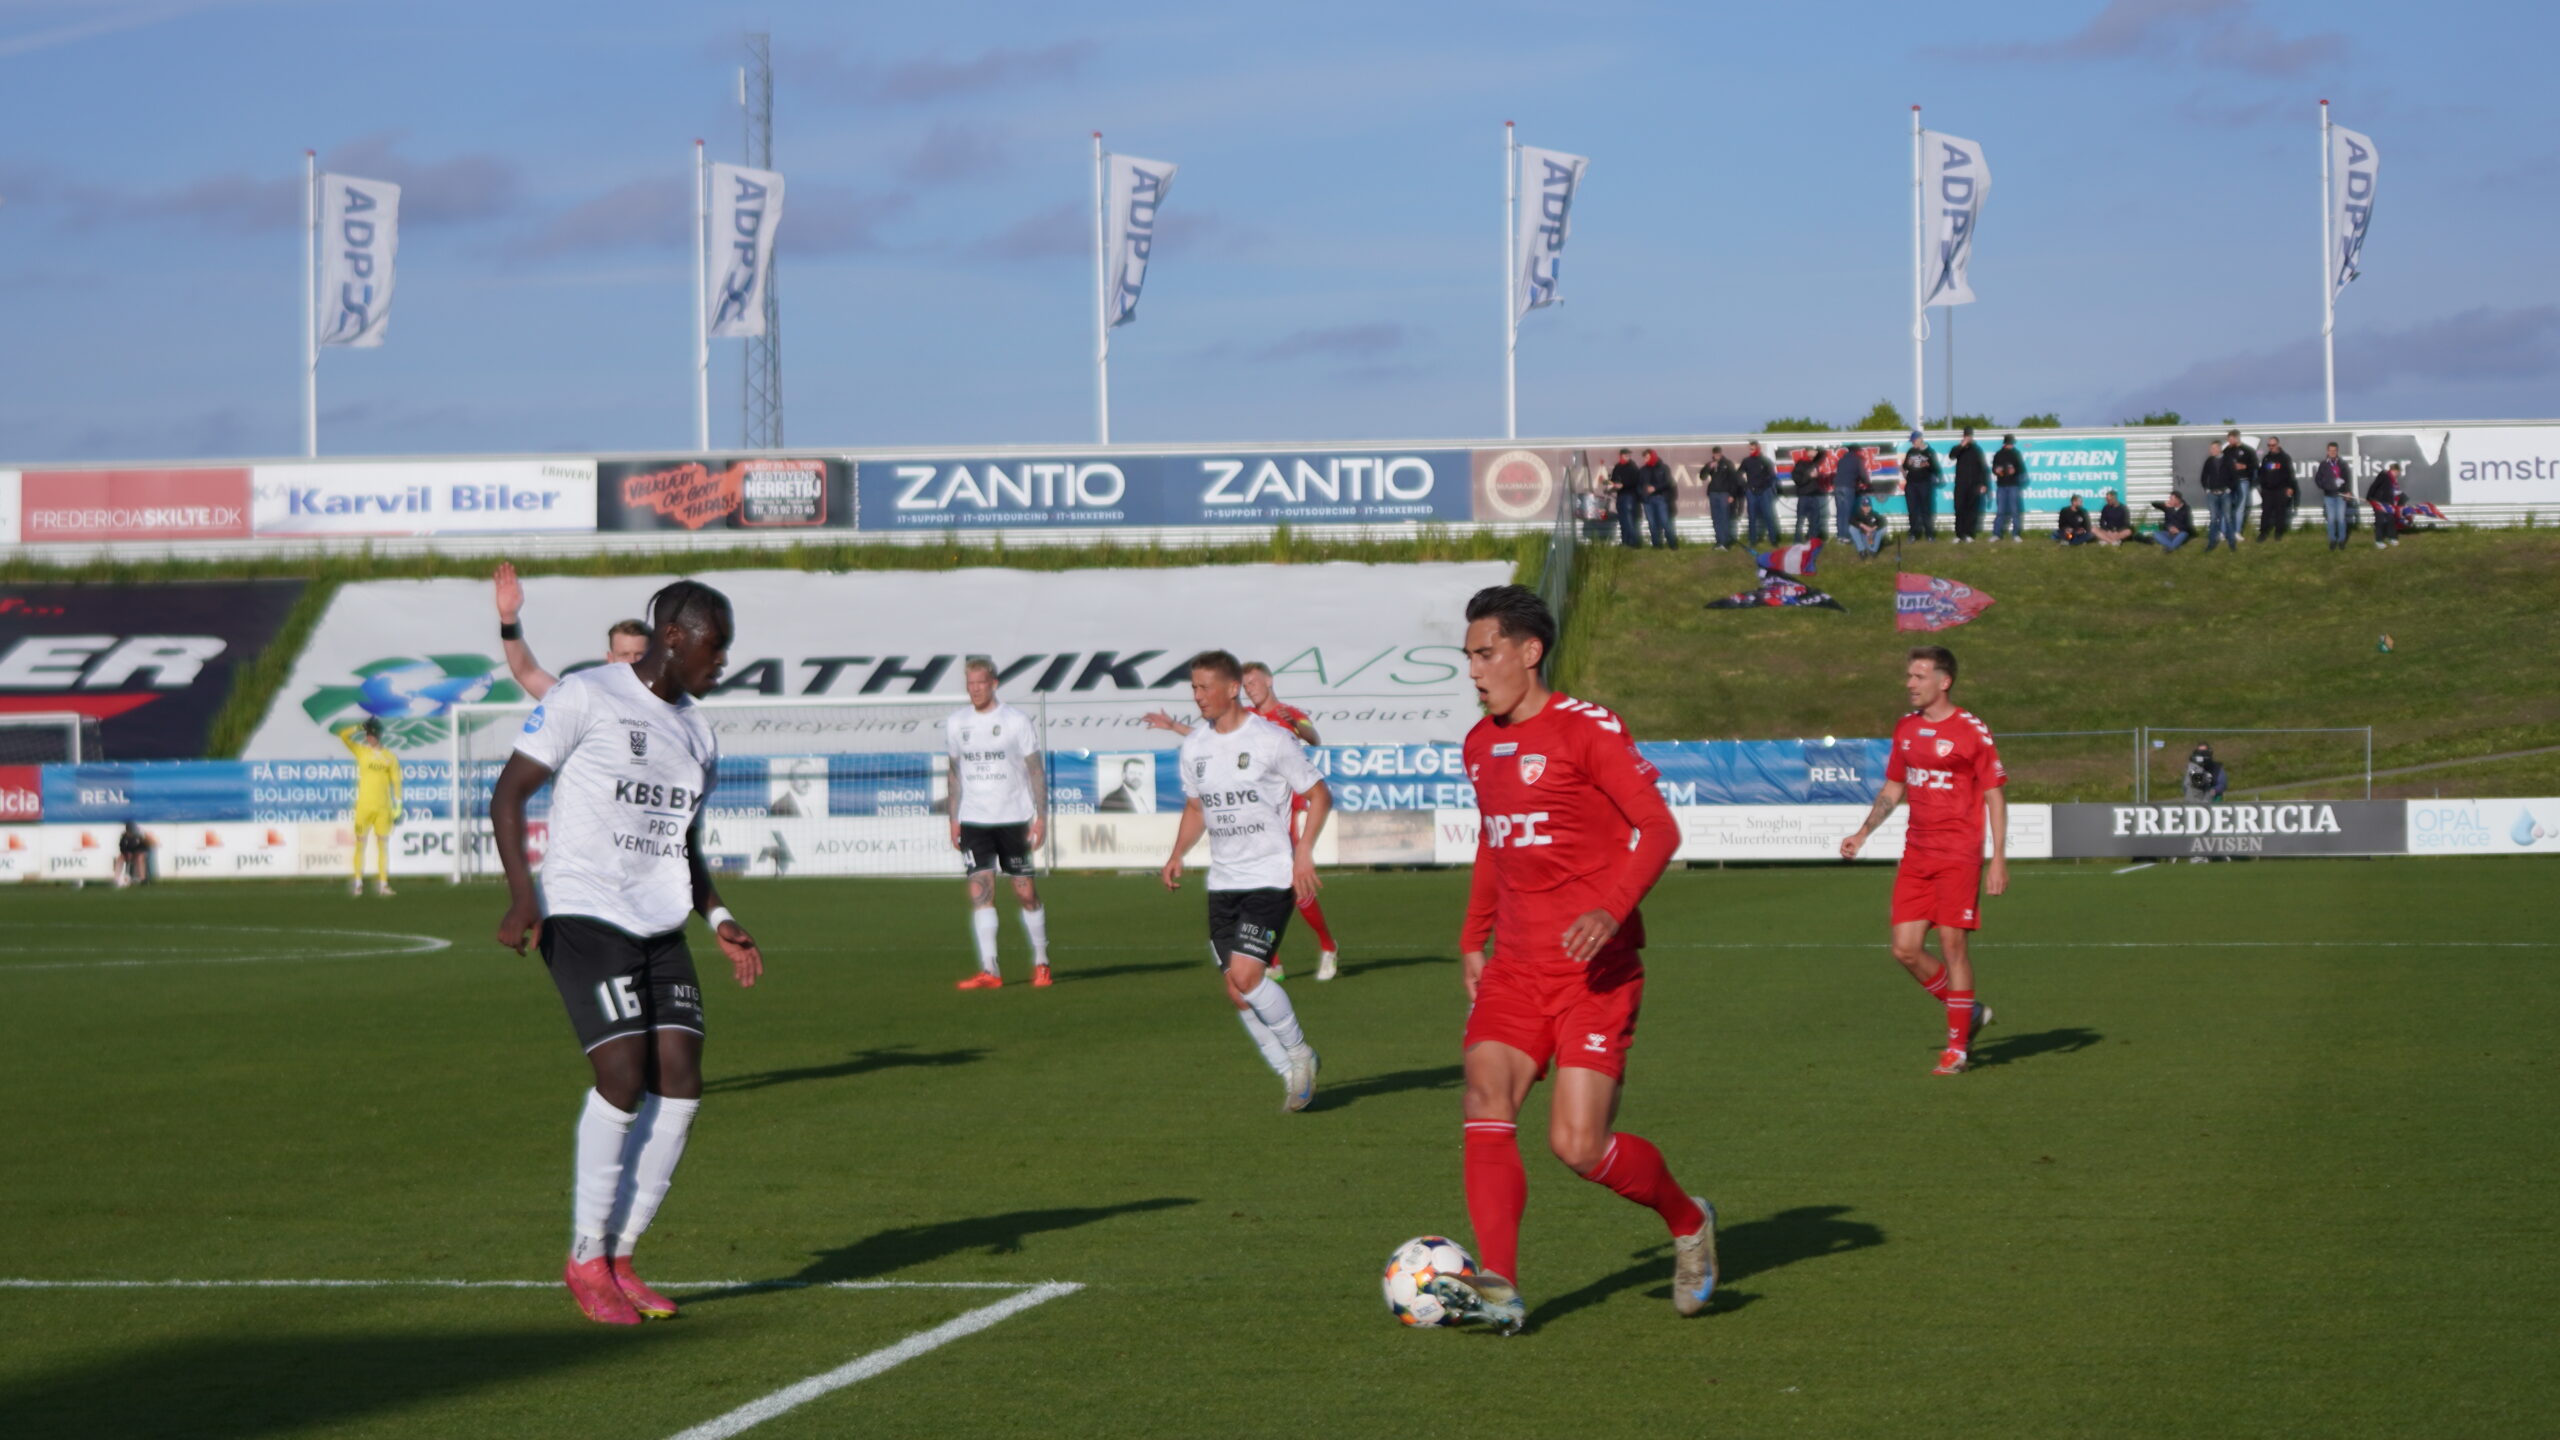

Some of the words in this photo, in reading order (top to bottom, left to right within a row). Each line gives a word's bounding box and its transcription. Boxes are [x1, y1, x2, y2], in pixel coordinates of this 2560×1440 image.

[541, 465, 593, 481] ERHVERV
[1202, 456, 1435, 504] ZANTIO
[2068, 471, 2119, 482] EVENTS
[745, 480, 822, 498] HERRETØJ
[896, 463, 1127, 509] ZANTIO
[289, 485, 432, 515] Karvil
[452, 484, 560, 512] Biler
[33, 507, 242, 529] FREDERICIASKILTE.DK
[898, 514, 955, 524] IT-SUPPORT
[963, 512, 1049, 523] IT-OUTSOURCING
[1056, 511, 1125, 521] IT-SIKKERHED
[1204, 509, 1263, 518] IT-SUPPORT
[1270, 507, 1357, 517] IT-OUTSOURCING
[1364, 505, 1434, 515] IT-SIKKERHED
[1272, 645, 1467, 688] A/S
[619, 717, 650, 728] uhlspo
[750, 718, 921, 735] Recycling
[984, 750, 1006, 761] BYG
[1342, 747, 1468, 777] SÆLGE
[253, 759, 274, 780] FÅ
[278, 765, 300, 780] EN
[1810, 766, 1862, 783] REAL
[81, 788, 130, 805] REAL
[254, 787, 359, 802] BOLIGBUTIK
[615, 779, 665, 807] KBS
[878, 789, 926, 802] SIMON
[1226, 789, 1260, 806] BYG
[253, 809, 333, 824] KONTAKT
[706, 807, 768, 819] RGAARD
[878, 804, 930, 818] NISSEN
[1216, 814, 1237, 824] PRO
[2414, 808, 2487, 831] OPAL
[648, 818, 679, 836] PRO
[1746, 814, 1803, 832] Snoghøj
[2113, 804, 2342, 836] FREDERICIA
[1720, 830, 1831, 849] Murerforretning
[2190, 836, 2264, 853] AVISEN
[2415, 829, 2491, 848] service
[50, 854, 89, 871] pwc
[174, 852, 213, 869] pwc
[235, 851, 274, 869] pwc
[305, 851, 343, 867] pwc
[599, 975, 643, 1023] 16
[673, 983, 700, 1001] NTG
